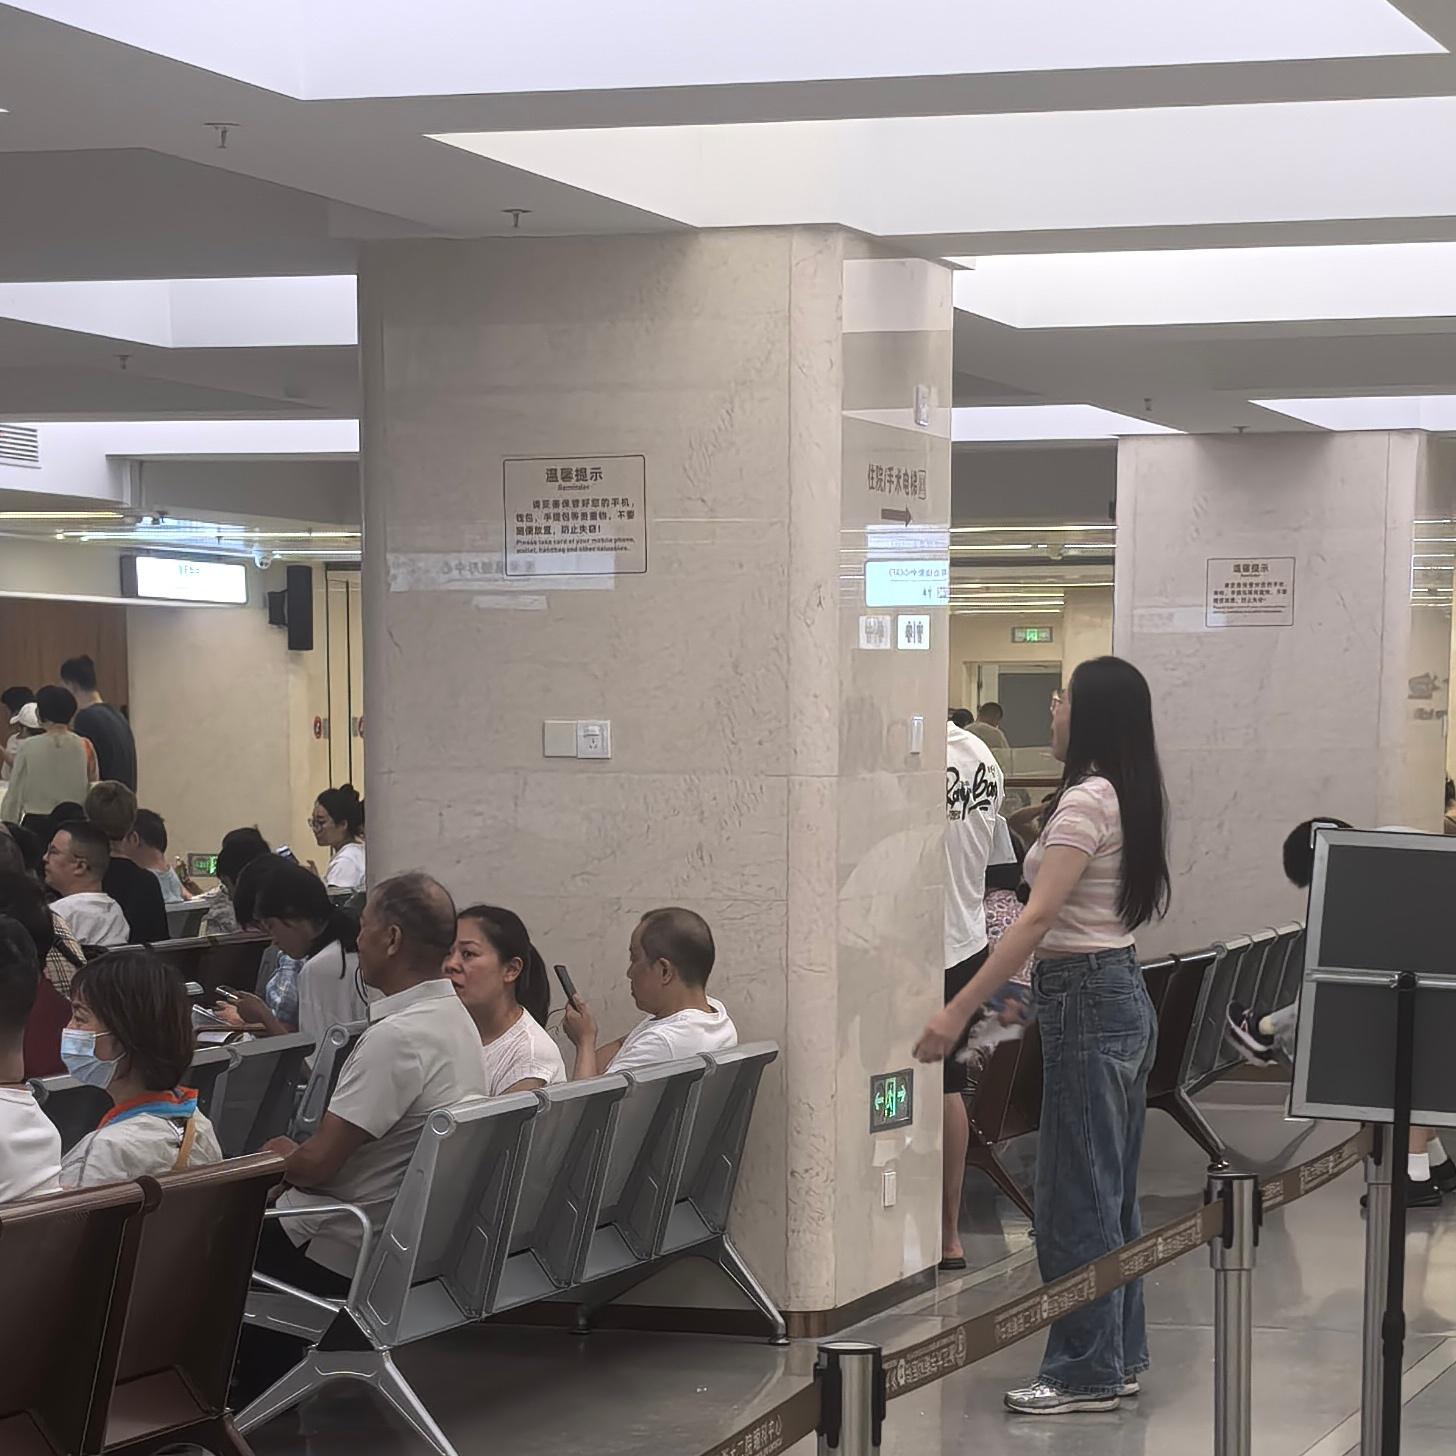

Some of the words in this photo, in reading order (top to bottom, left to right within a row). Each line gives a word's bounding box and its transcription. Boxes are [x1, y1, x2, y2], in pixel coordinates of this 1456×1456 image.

[545, 466, 604, 483] 温馨提示
[867, 463, 919, 497] 住院/手术电梯
